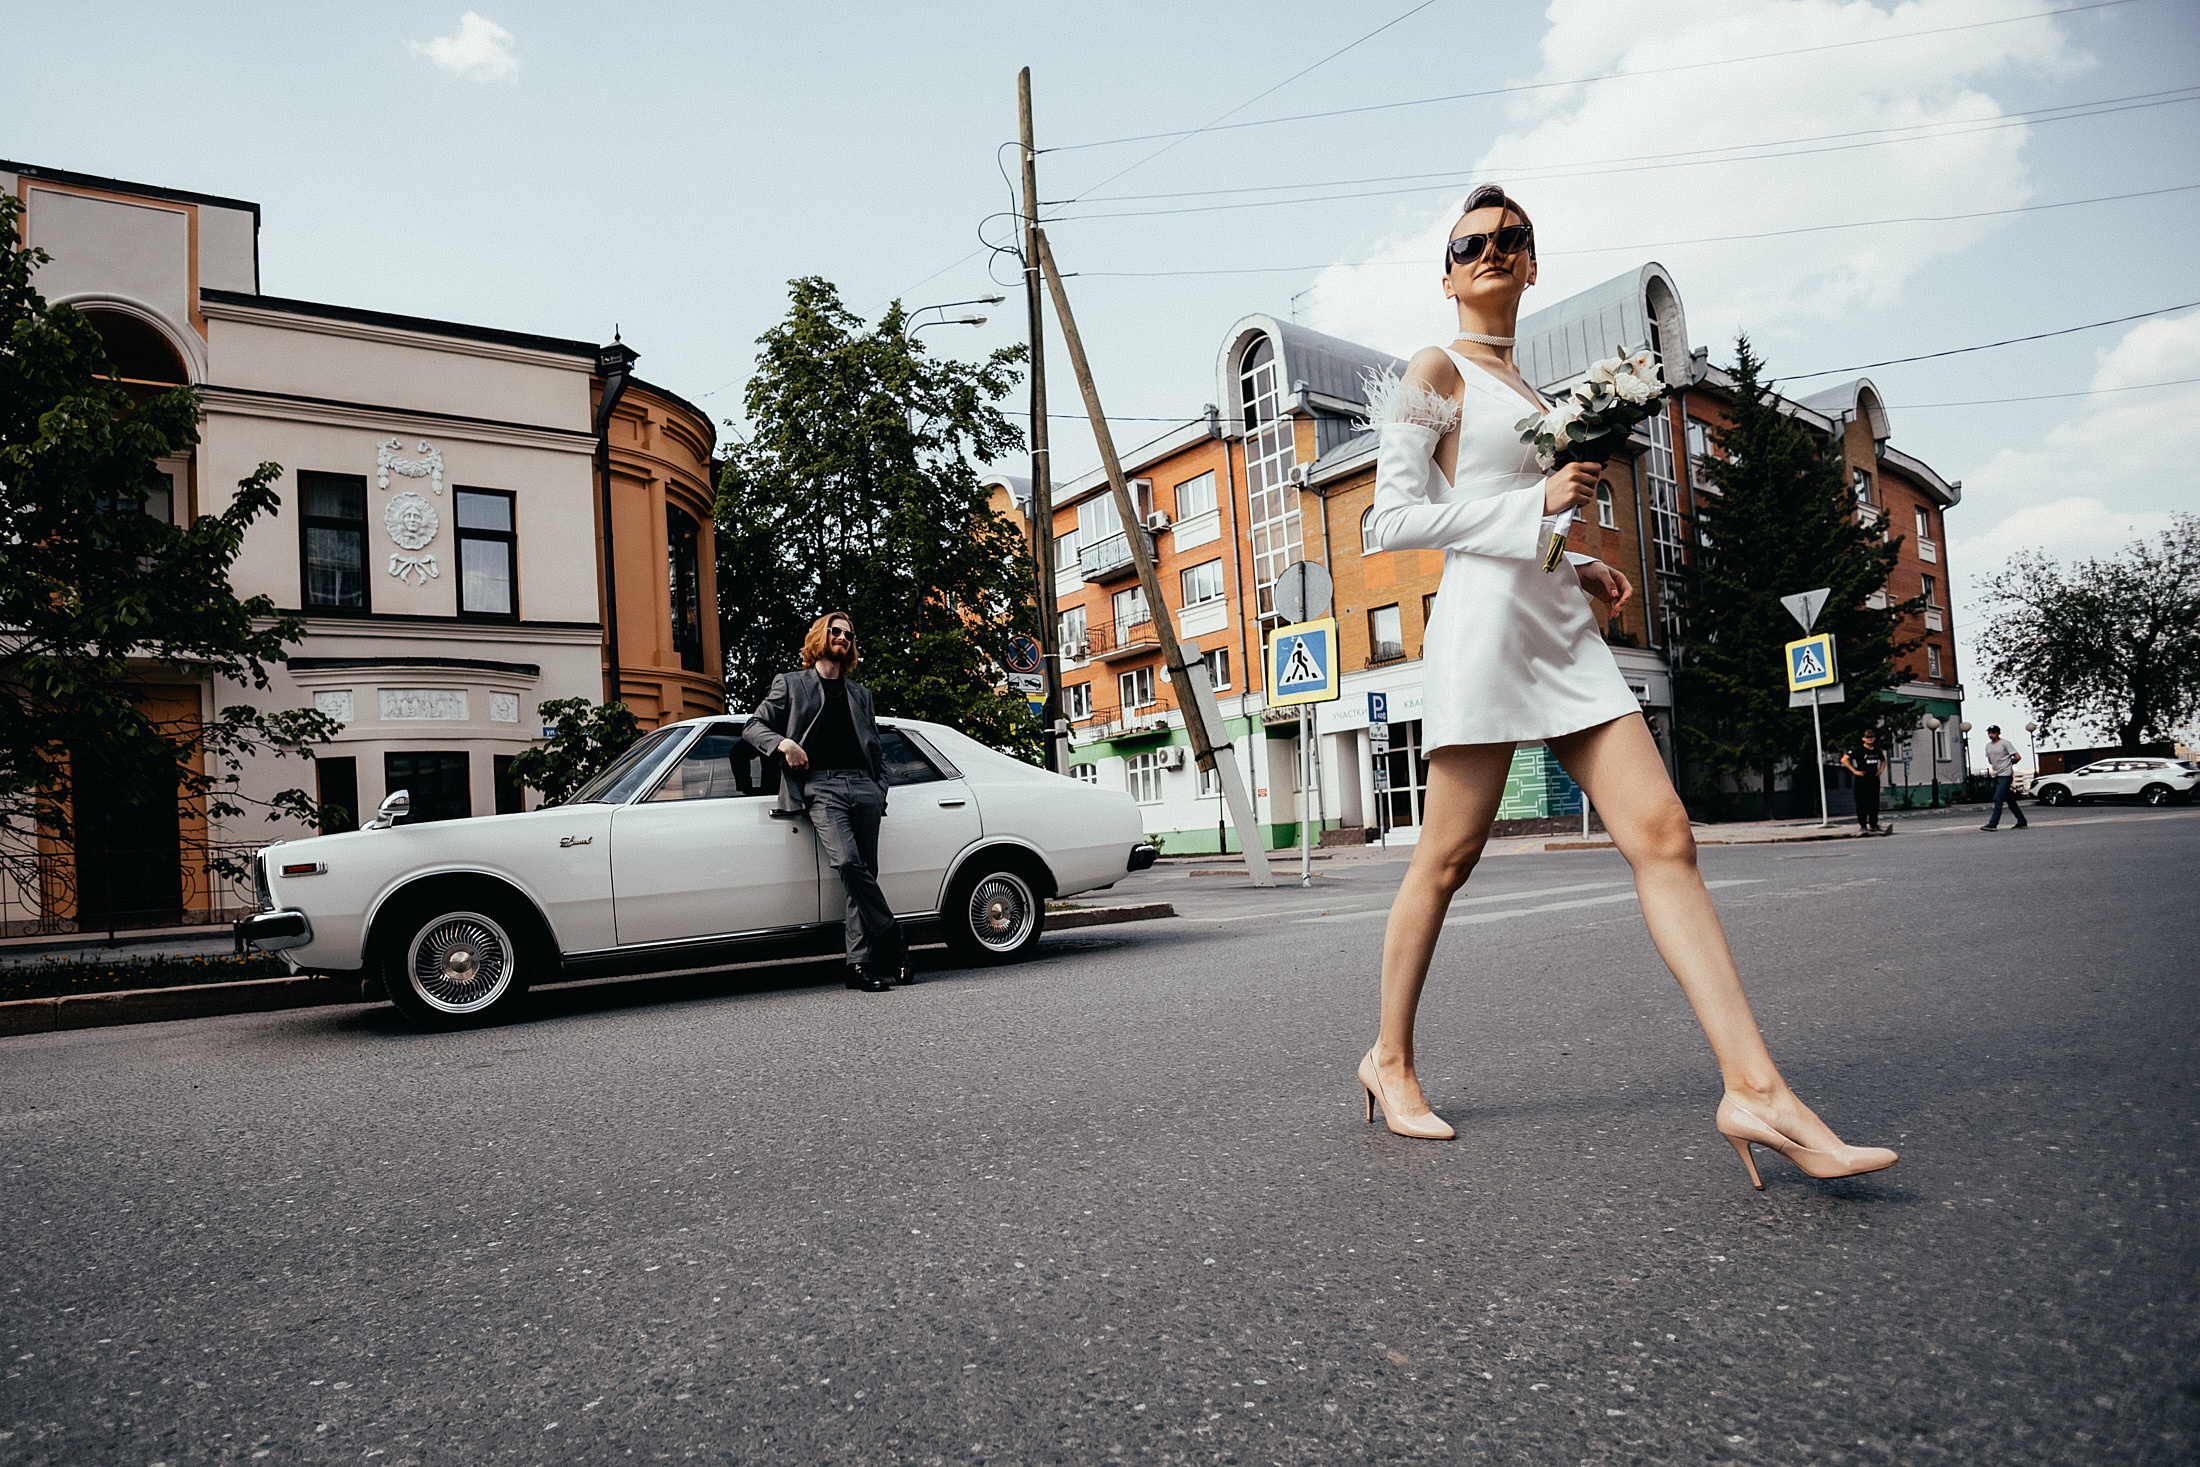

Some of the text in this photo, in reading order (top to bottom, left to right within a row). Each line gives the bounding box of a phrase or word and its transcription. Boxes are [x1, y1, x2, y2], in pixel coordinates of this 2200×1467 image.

[1332, 698, 1423, 720] УЧАСТКИ КВА
[1372, 695, 1385, 720] P
